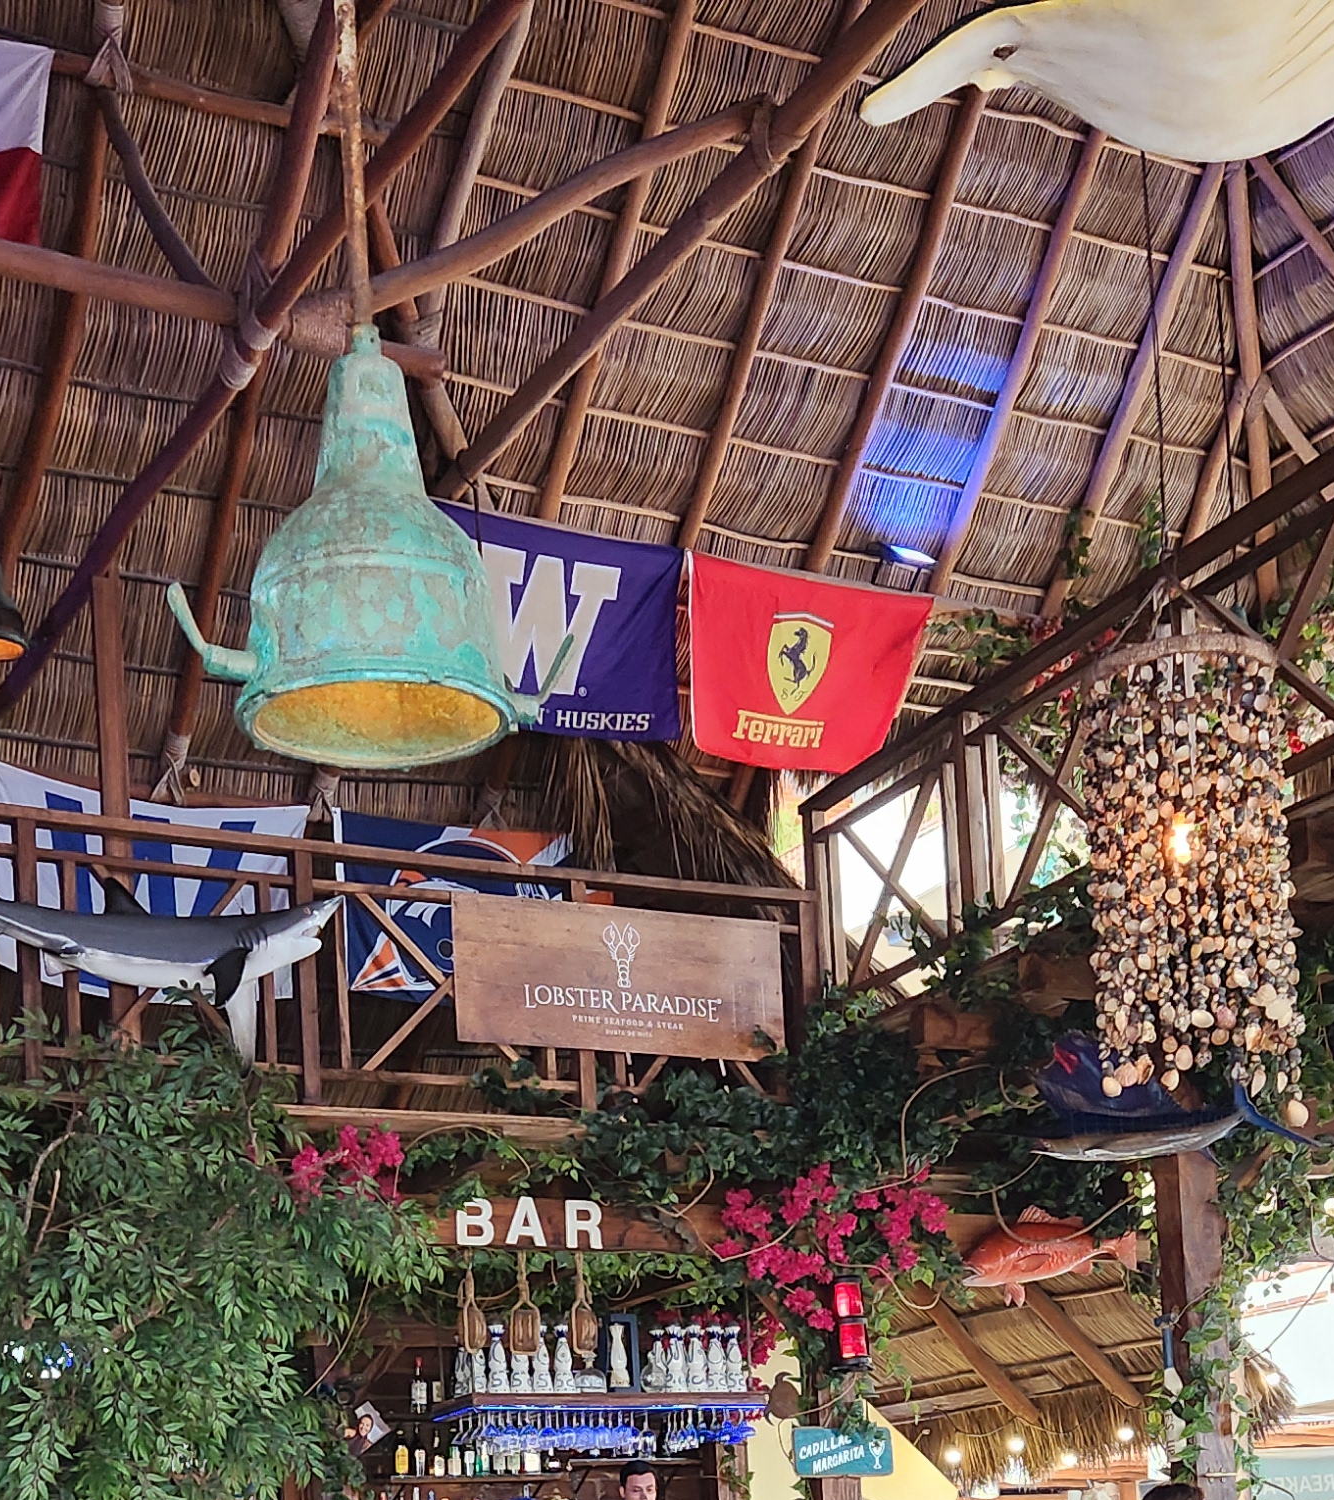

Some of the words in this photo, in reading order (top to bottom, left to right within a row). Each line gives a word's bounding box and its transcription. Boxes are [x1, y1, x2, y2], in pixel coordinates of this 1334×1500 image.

[555, 709, 650, 732] HUSKIES
[731, 709, 825, 749] Ferrari
[523, 983, 620, 1014] LOBSTER
[621, 991, 721, 1023] PARADISE
[571, 1014, 601, 1025] PRIME
[603, 1017, 644, 1028] SEAFOOD
[656, 1021, 684, 1031] STEAK
[456, 1196, 604, 1249] BAR
[812, 1444, 865, 1475] MARGARITA
